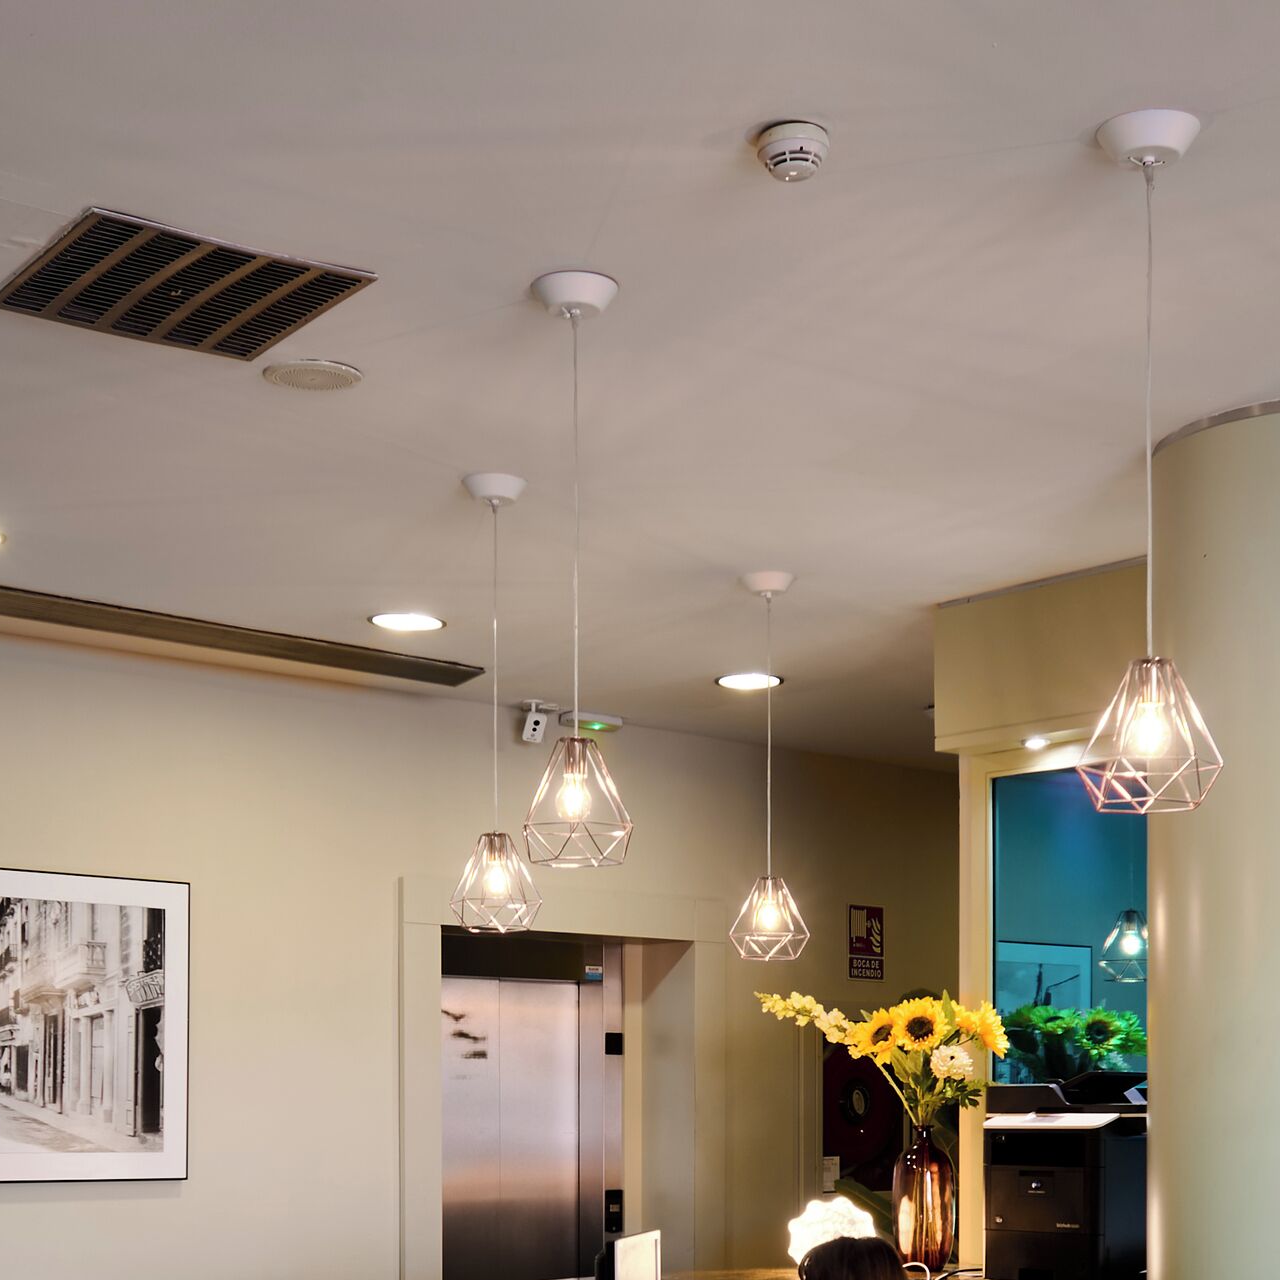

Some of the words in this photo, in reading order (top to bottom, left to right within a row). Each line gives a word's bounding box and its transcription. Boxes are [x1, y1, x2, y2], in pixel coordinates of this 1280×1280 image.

[852, 959, 870, 968] BOCA
[871, 960, 880, 969] DE
[851, 968, 882, 978] INCENDIO
